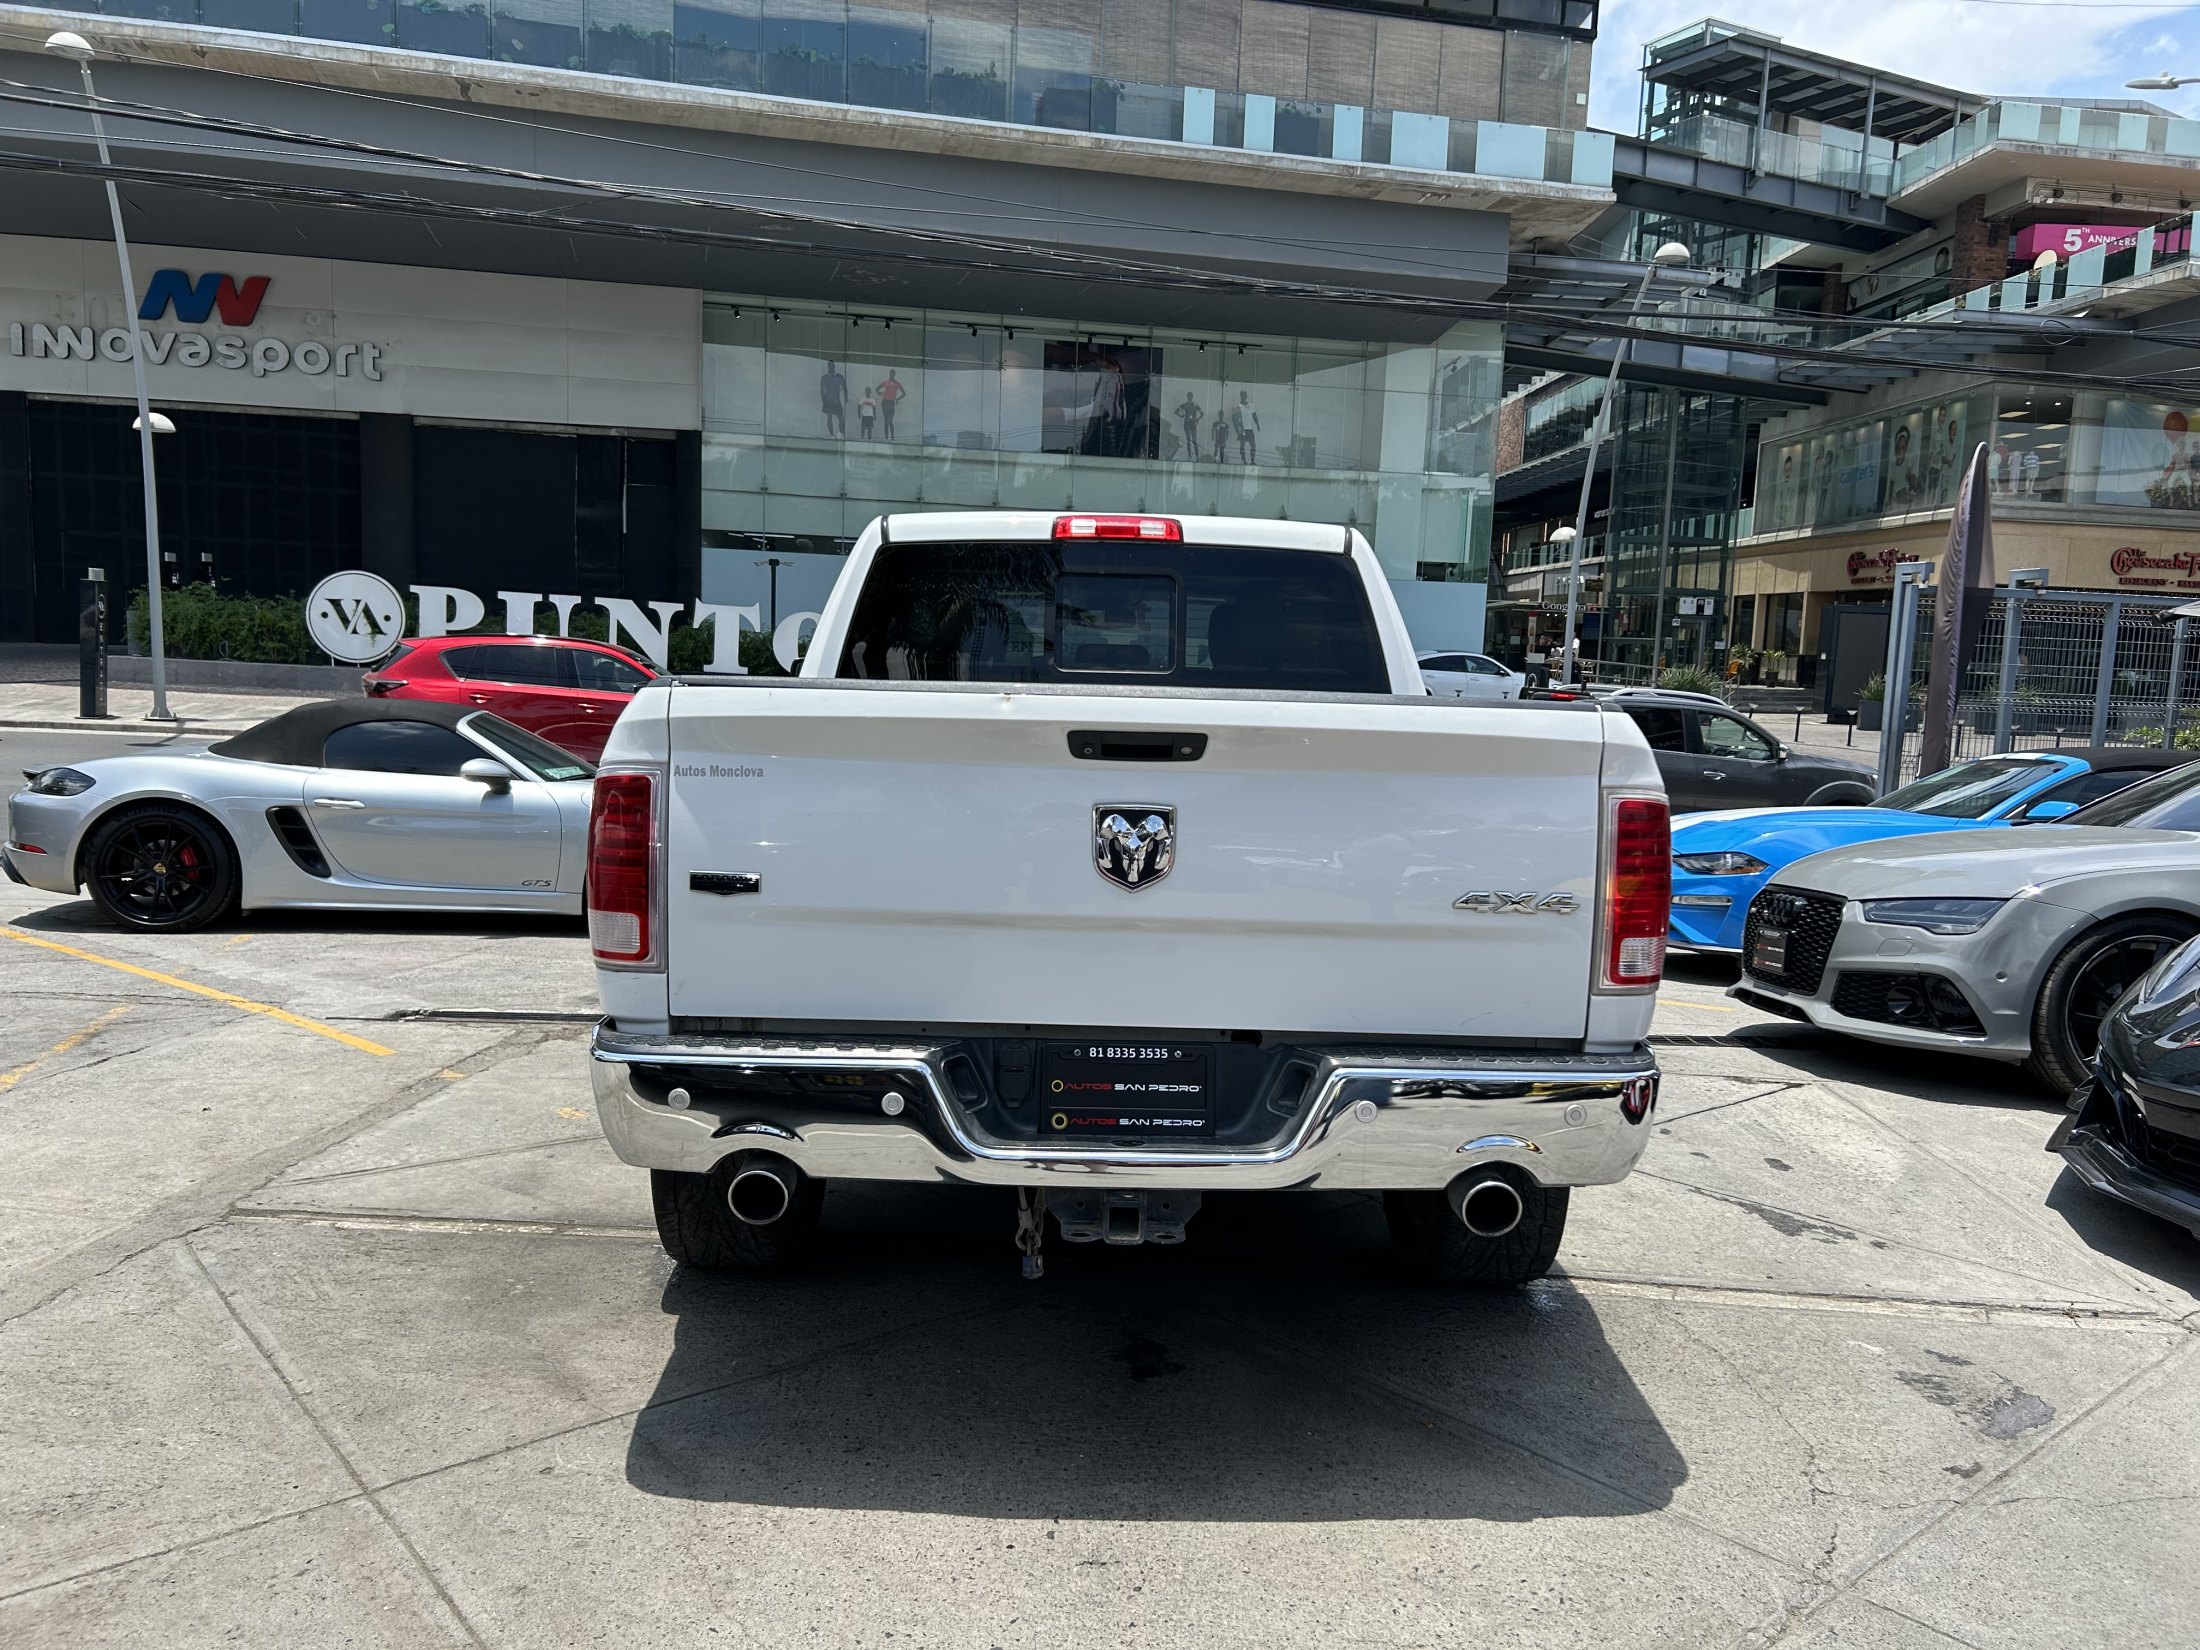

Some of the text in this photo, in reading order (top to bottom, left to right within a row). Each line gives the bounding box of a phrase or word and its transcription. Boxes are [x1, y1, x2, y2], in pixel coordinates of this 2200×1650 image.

[2110, 547, 2190, 576] Cheesecake
[2118, 577, 2169, 587] RESTAURANT
[1541, 600, 1569, 613] Gong
[673, 764, 764, 778] Autos Monclova
[521, 879, 552, 887] GTS
[1452, 890, 1580, 914] 4X4
[1089, 1047, 1168, 1059] 81 8335 3535
[1114, 1083, 1146, 1091] SAN
[1069, 1118, 1117, 1126] AUTOS
[1119, 1118, 1150, 1126] SAN
